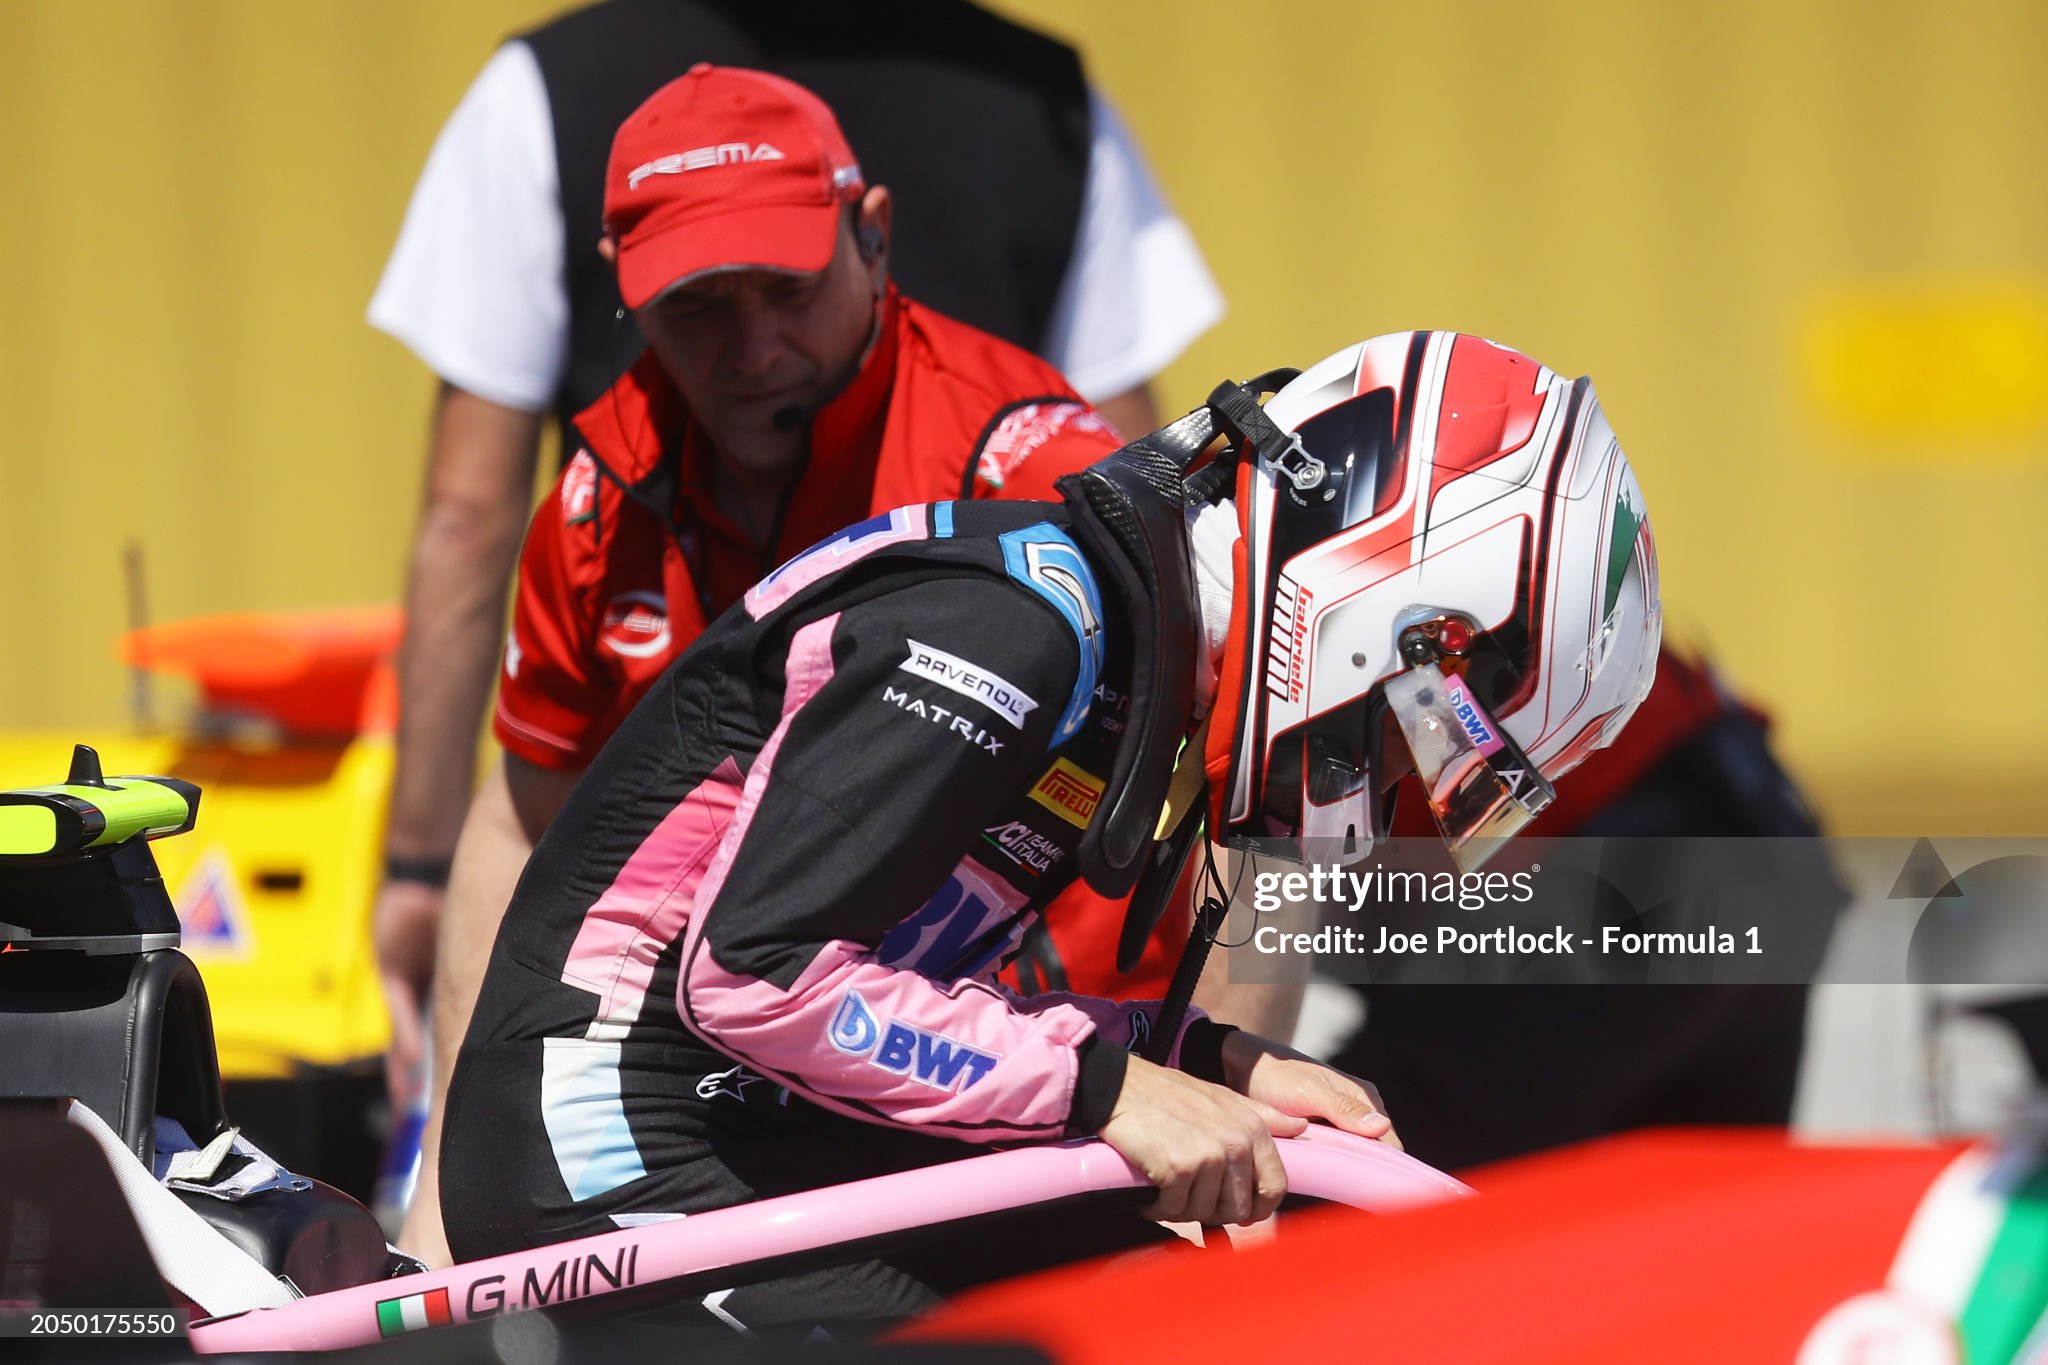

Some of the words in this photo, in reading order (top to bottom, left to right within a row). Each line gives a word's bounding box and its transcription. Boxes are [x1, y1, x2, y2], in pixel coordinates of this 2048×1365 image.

[627, 142, 786, 191] PREMA
[915, 653, 1020, 717] RAVENOL
[882, 686, 1005, 757] MATRIX
[1455, 701, 1493, 746] BWT
[1012, 842, 1051, 873] ITALIA
[1026, 834, 1058, 861] TEAM
[876, 1023, 998, 1092] BWT
[466, 1244, 640, 1320] G.MINI
